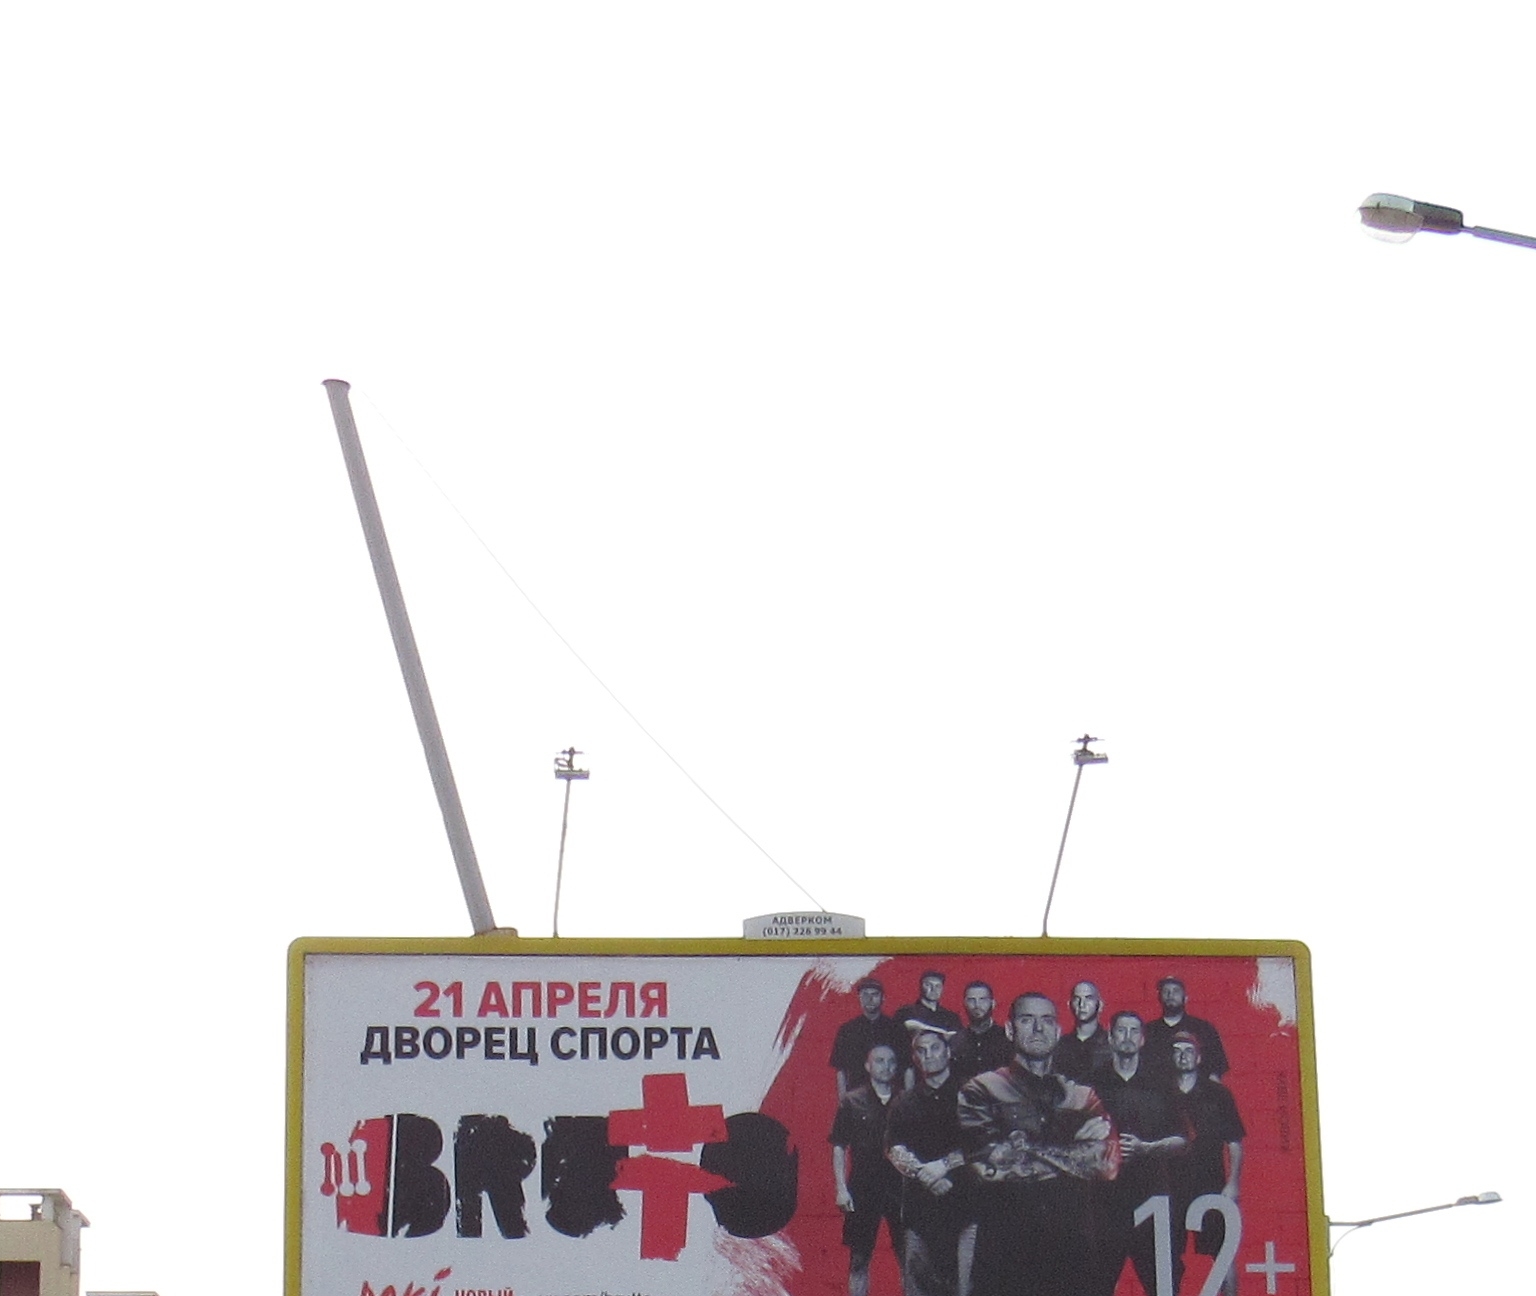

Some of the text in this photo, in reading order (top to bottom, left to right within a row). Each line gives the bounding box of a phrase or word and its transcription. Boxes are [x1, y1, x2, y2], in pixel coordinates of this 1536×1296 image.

[762, 926, 791, 938] (017)
[772, 915, 833, 926] АДВЕРКОМ
[413, 980, 669, 1019] 21 АПРЕЛЯ
[359, 1025, 722, 1067] ДВОРЕЦ СПОРТА
